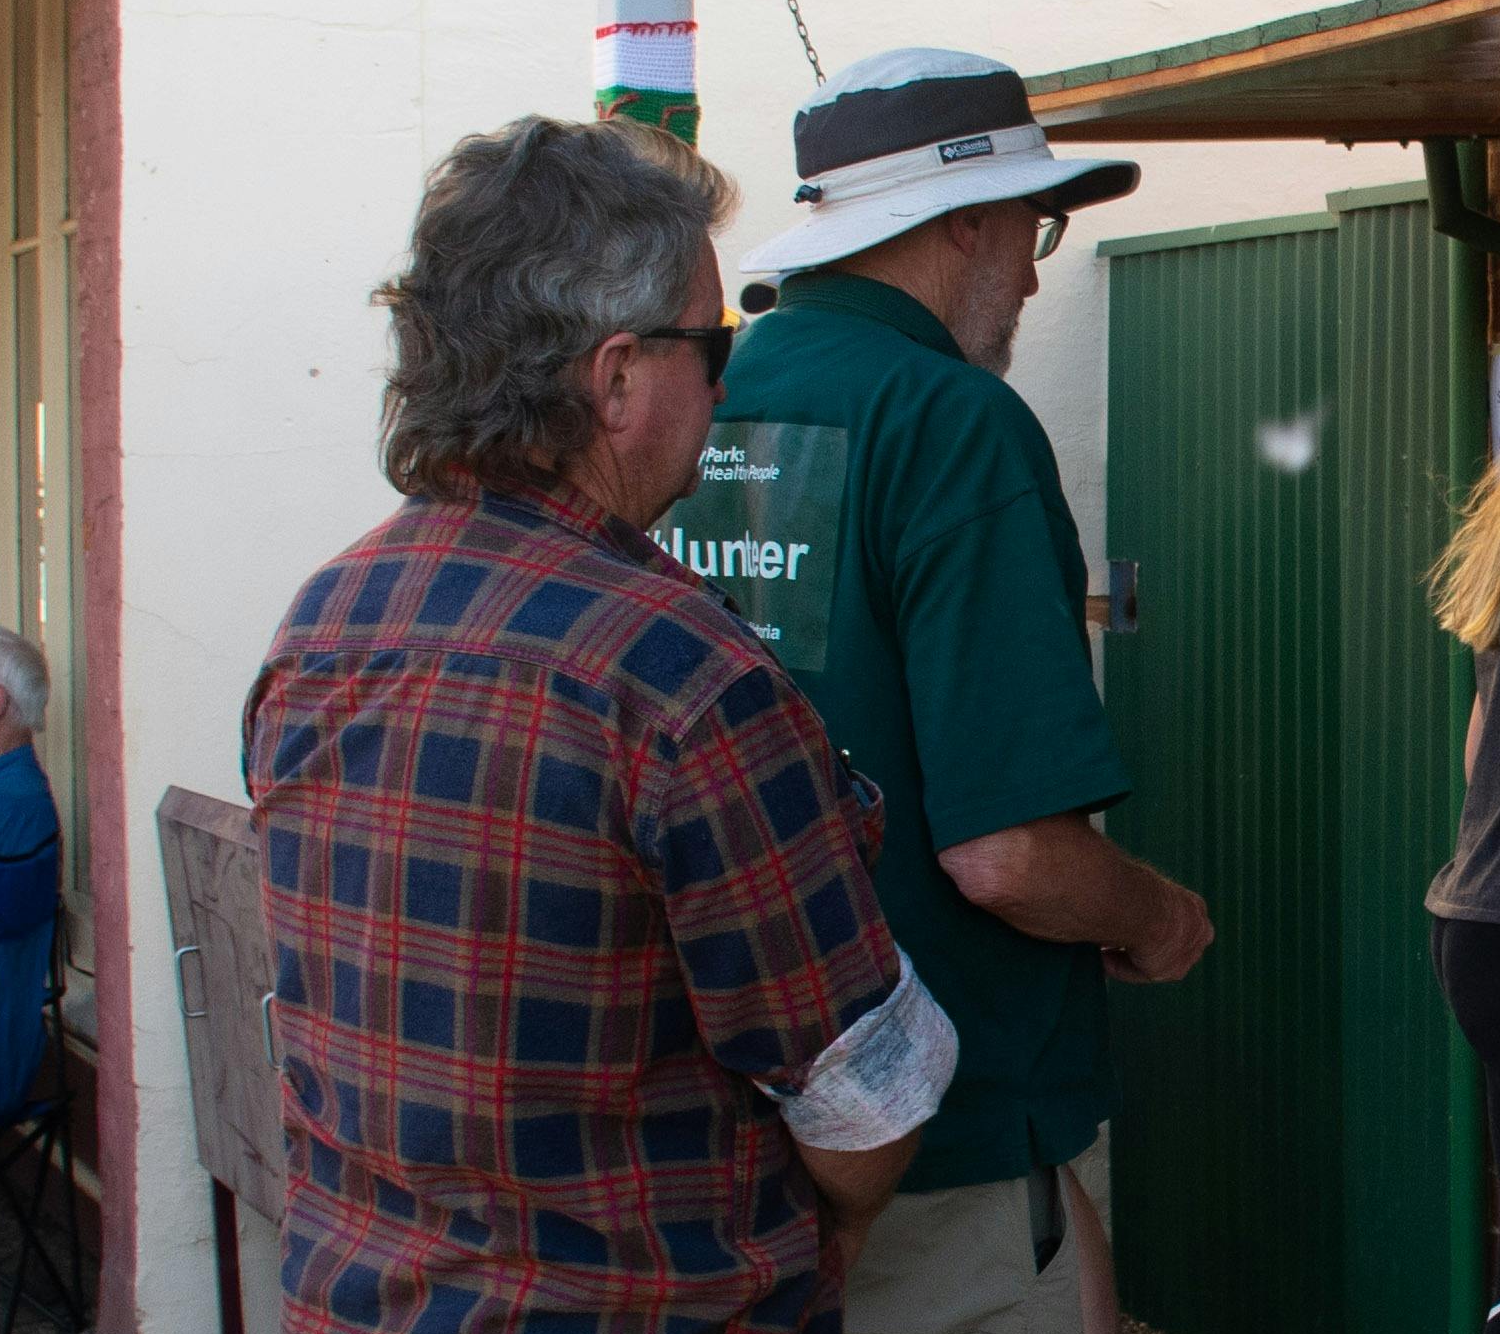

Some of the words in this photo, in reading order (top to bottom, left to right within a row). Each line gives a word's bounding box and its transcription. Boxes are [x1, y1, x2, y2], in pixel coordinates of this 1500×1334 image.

[706, 445, 746, 464] Parks
[703, 464, 749, 484] Healt
[644, 528, 810, 580] lunteer
